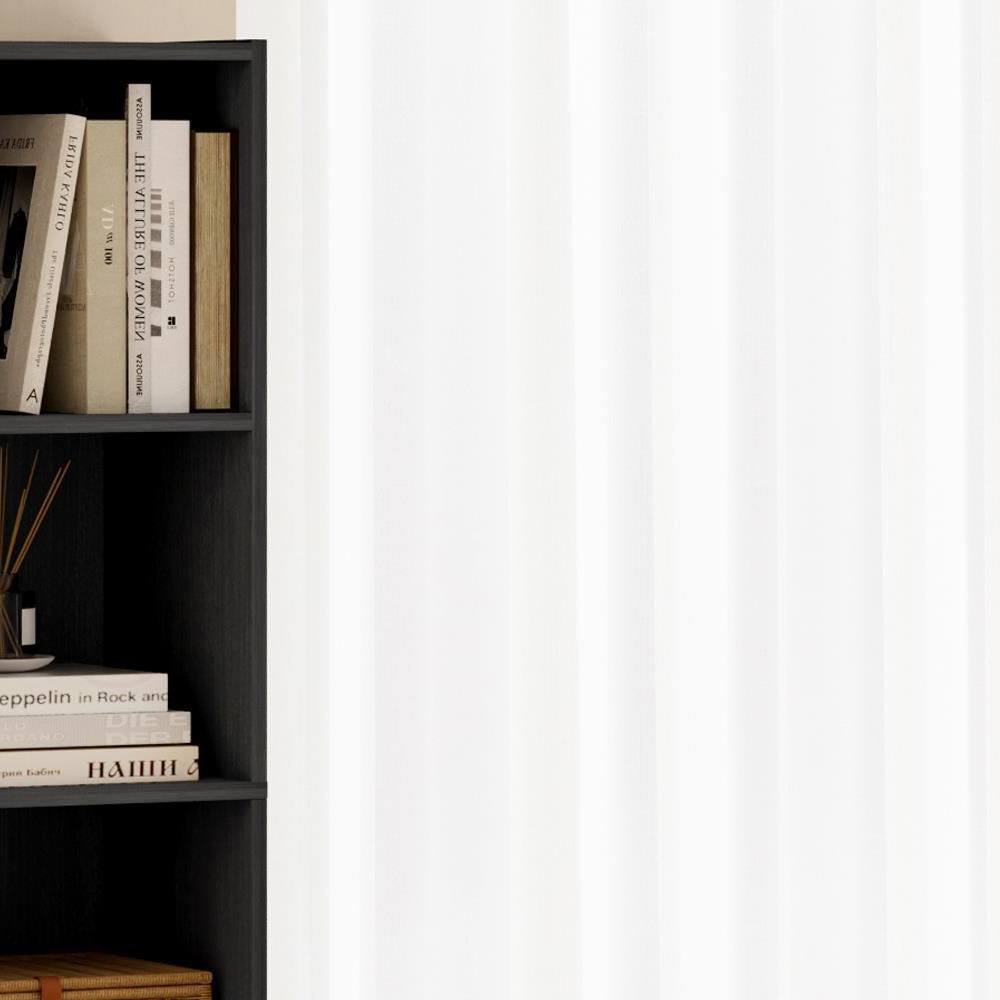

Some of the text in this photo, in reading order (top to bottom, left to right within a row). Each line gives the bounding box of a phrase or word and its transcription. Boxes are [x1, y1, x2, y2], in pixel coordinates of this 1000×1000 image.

[26, 388, 38, 403] A
[79, 691, 92, 703] in
[98, 690, 136, 703] Rock
[107, 714, 159, 728] DIE
